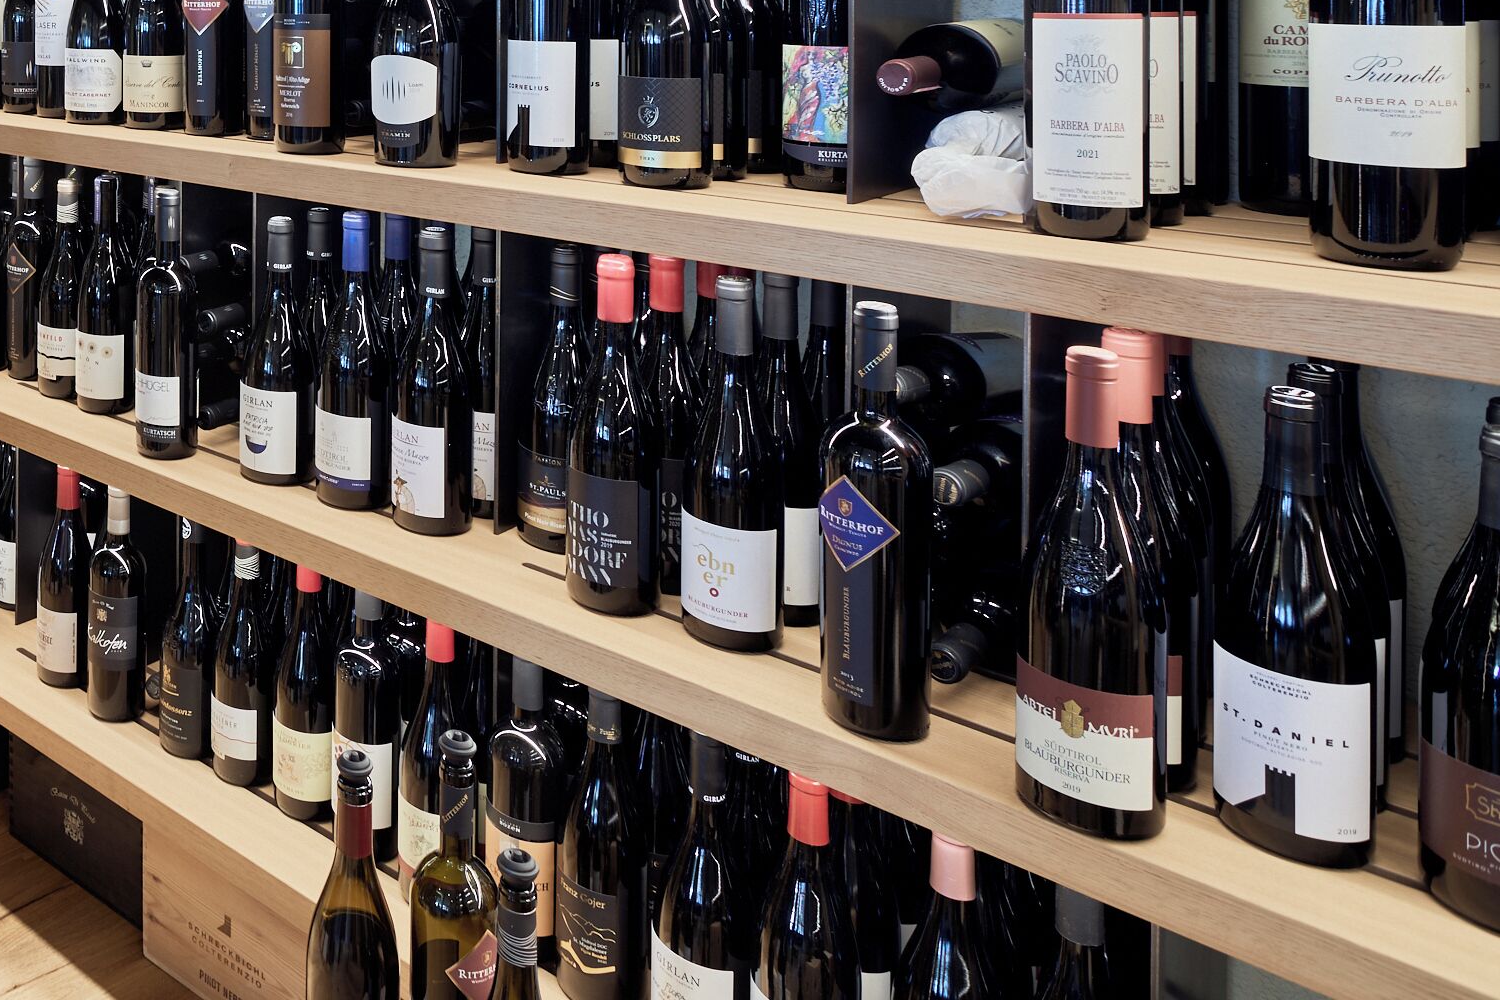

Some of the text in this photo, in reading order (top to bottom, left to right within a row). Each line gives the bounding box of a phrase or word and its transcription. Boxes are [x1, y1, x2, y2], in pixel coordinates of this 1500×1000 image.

[183, 0, 221, 8] RITTERHOF
[36, 21, 57, 29] LASER
[1273, 24, 1309, 35] CAM
[1263, 36, 1279, 46] du
[1066, 53, 1107, 69] PAOLO
[1344, 53, 1453, 84] Prunotto
[1054, 63, 1119, 85] SCAVINO
[279, 89, 303, 98] MERLOT
[1335, 95, 1458, 108] BARBERA D'ALBA
[129, 99, 170, 109] MANINCOR
[1050, 119, 1125, 132] BARBERA D'ALBA
[818, 150, 848, 160] KURTA
[1076, 148, 1099, 159] 2021
[857, 342, 894, 379] RITTERHOF
[242, 393, 273, 408] GIRLAN
[570, 500, 609, 528] THO
[820, 505, 885, 537] RITTERHOF
[549, 520, 567, 530] Riser
[570, 542, 627, 570] DORF
[696, 550, 735, 576] ebn
[703, 569, 728, 588] er
[688, 594, 749, 619] BLAUBURGUNDER
[842, 586, 850, 660] BLAUBURGUNDER
[1249, 673, 1312, 696] SCHRECKBICHL
[1252, 680, 1309, 700] COLTERENZIO
[1254, 719, 1351, 749] DANIEL
[735, 751, 760, 763] GIRLAN
[1024, 740, 1132, 785] BLAUBURGUNDER
[1043, 738, 1102, 767] SÜDTIROL
[1053, 764, 1090, 784] RISERVA
[1062, 781, 1082, 794] 2019
[1337, 828, 1357, 836] 2019
[560, 876, 606, 910] Franz Gojer
[187, 921, 267, 981] SCHRECKBICHL
[191, 934, 263, 989] COLTERENZIO
[656, 950, 701, 988] GIRLAN
[198, 968, 221, 994] PINOT
[457, 965, 497, 980] RITTER
